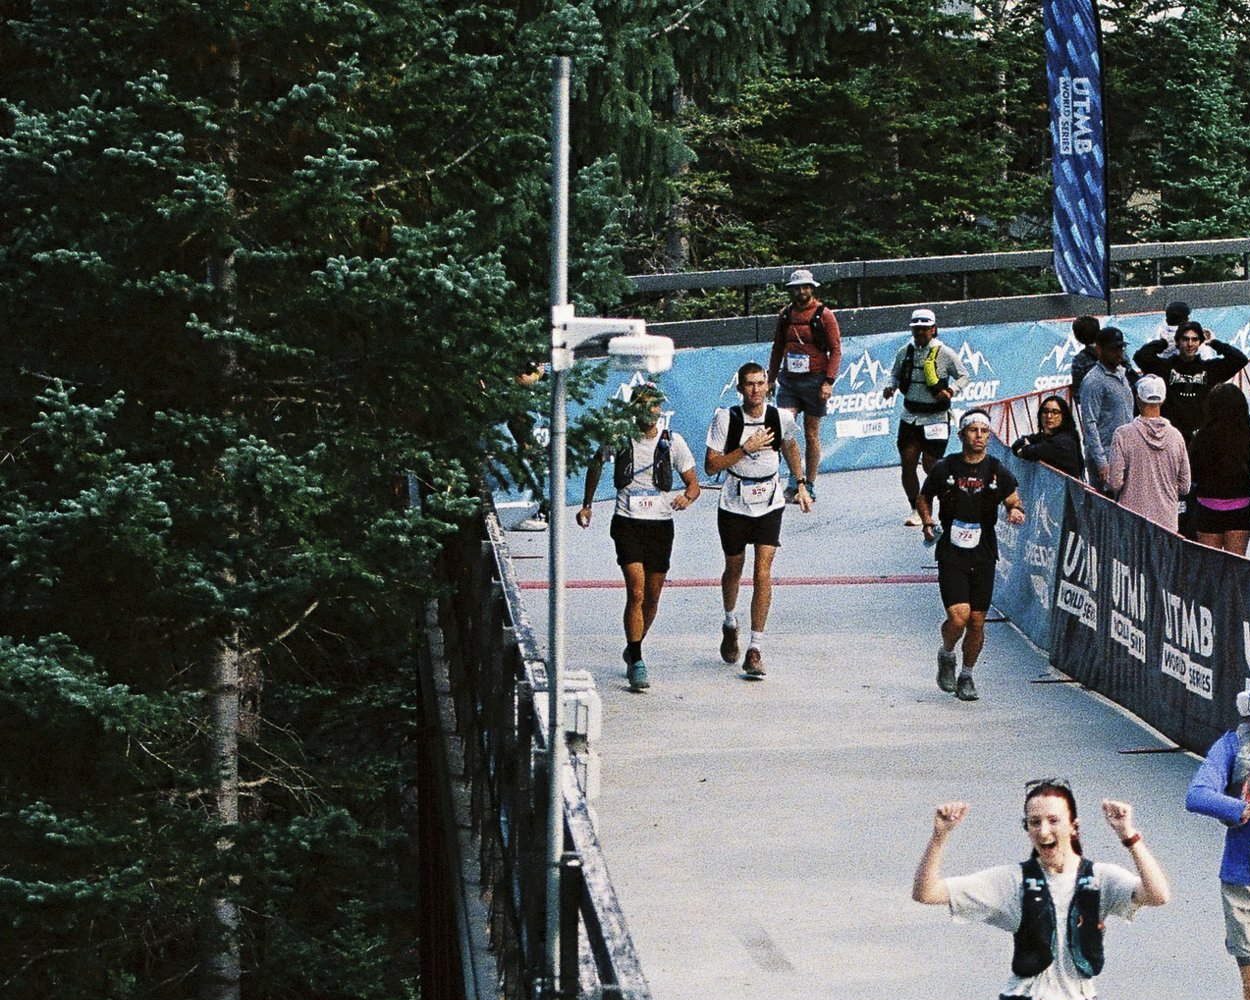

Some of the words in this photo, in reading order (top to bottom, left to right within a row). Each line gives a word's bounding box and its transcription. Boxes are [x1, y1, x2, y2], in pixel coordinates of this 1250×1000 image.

[1061, 120, 1070, 152] SERIES
[1073, 77, 1092, 154] UTMB
[1162, 589, 1214, 658] UTMB
